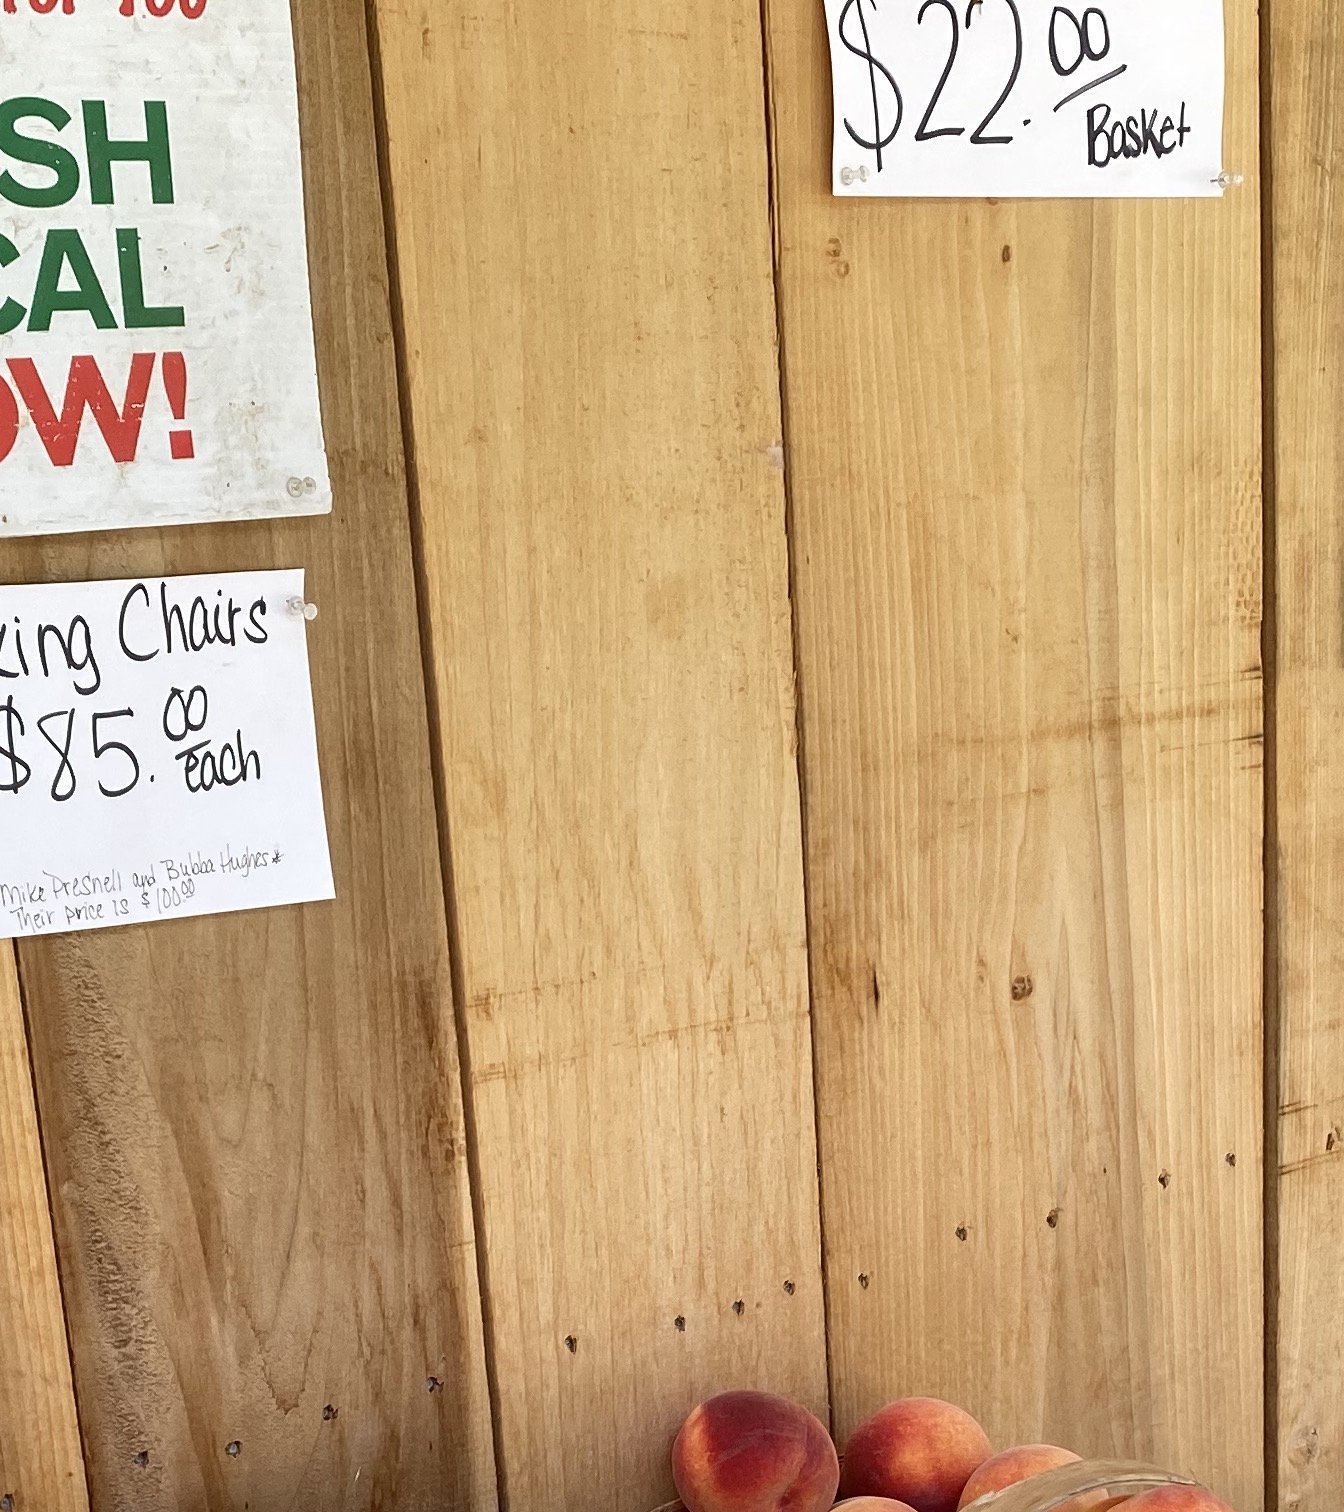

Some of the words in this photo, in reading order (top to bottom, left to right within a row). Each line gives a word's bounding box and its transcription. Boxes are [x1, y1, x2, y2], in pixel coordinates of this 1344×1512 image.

[1087, 101, 1191, 168] Basket
[119, 582, 268, 662] Chairs
[175, 729, 261, 794] Each
[0, 882, 46, 907] Mike
[132, 864, 156, 893] and
[160, 851, 216, 881] Bubba
[10, 905, 55, 934] Their
[65, 900, 104, 926] price
